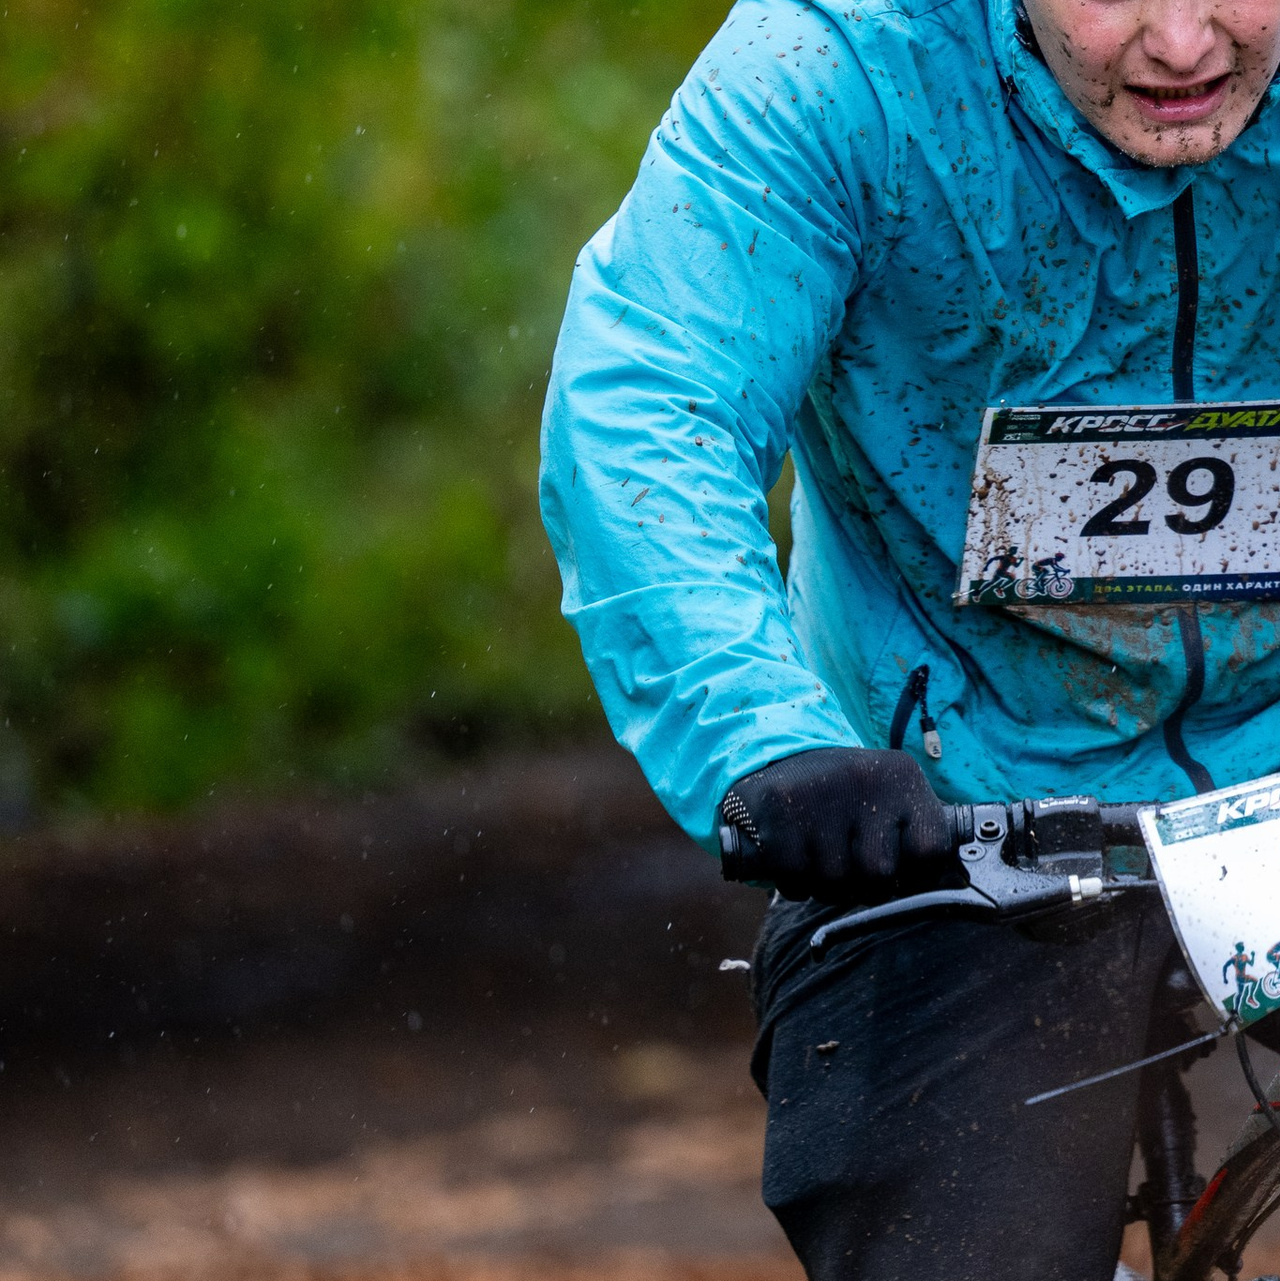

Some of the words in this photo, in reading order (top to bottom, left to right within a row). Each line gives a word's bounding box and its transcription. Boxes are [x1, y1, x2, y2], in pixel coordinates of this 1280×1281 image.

[1046, 412, 1180, 435] КРОСС
[1079, 456, 1236, 538] 29
[1182, 582, 1222, 592] ОДИН
